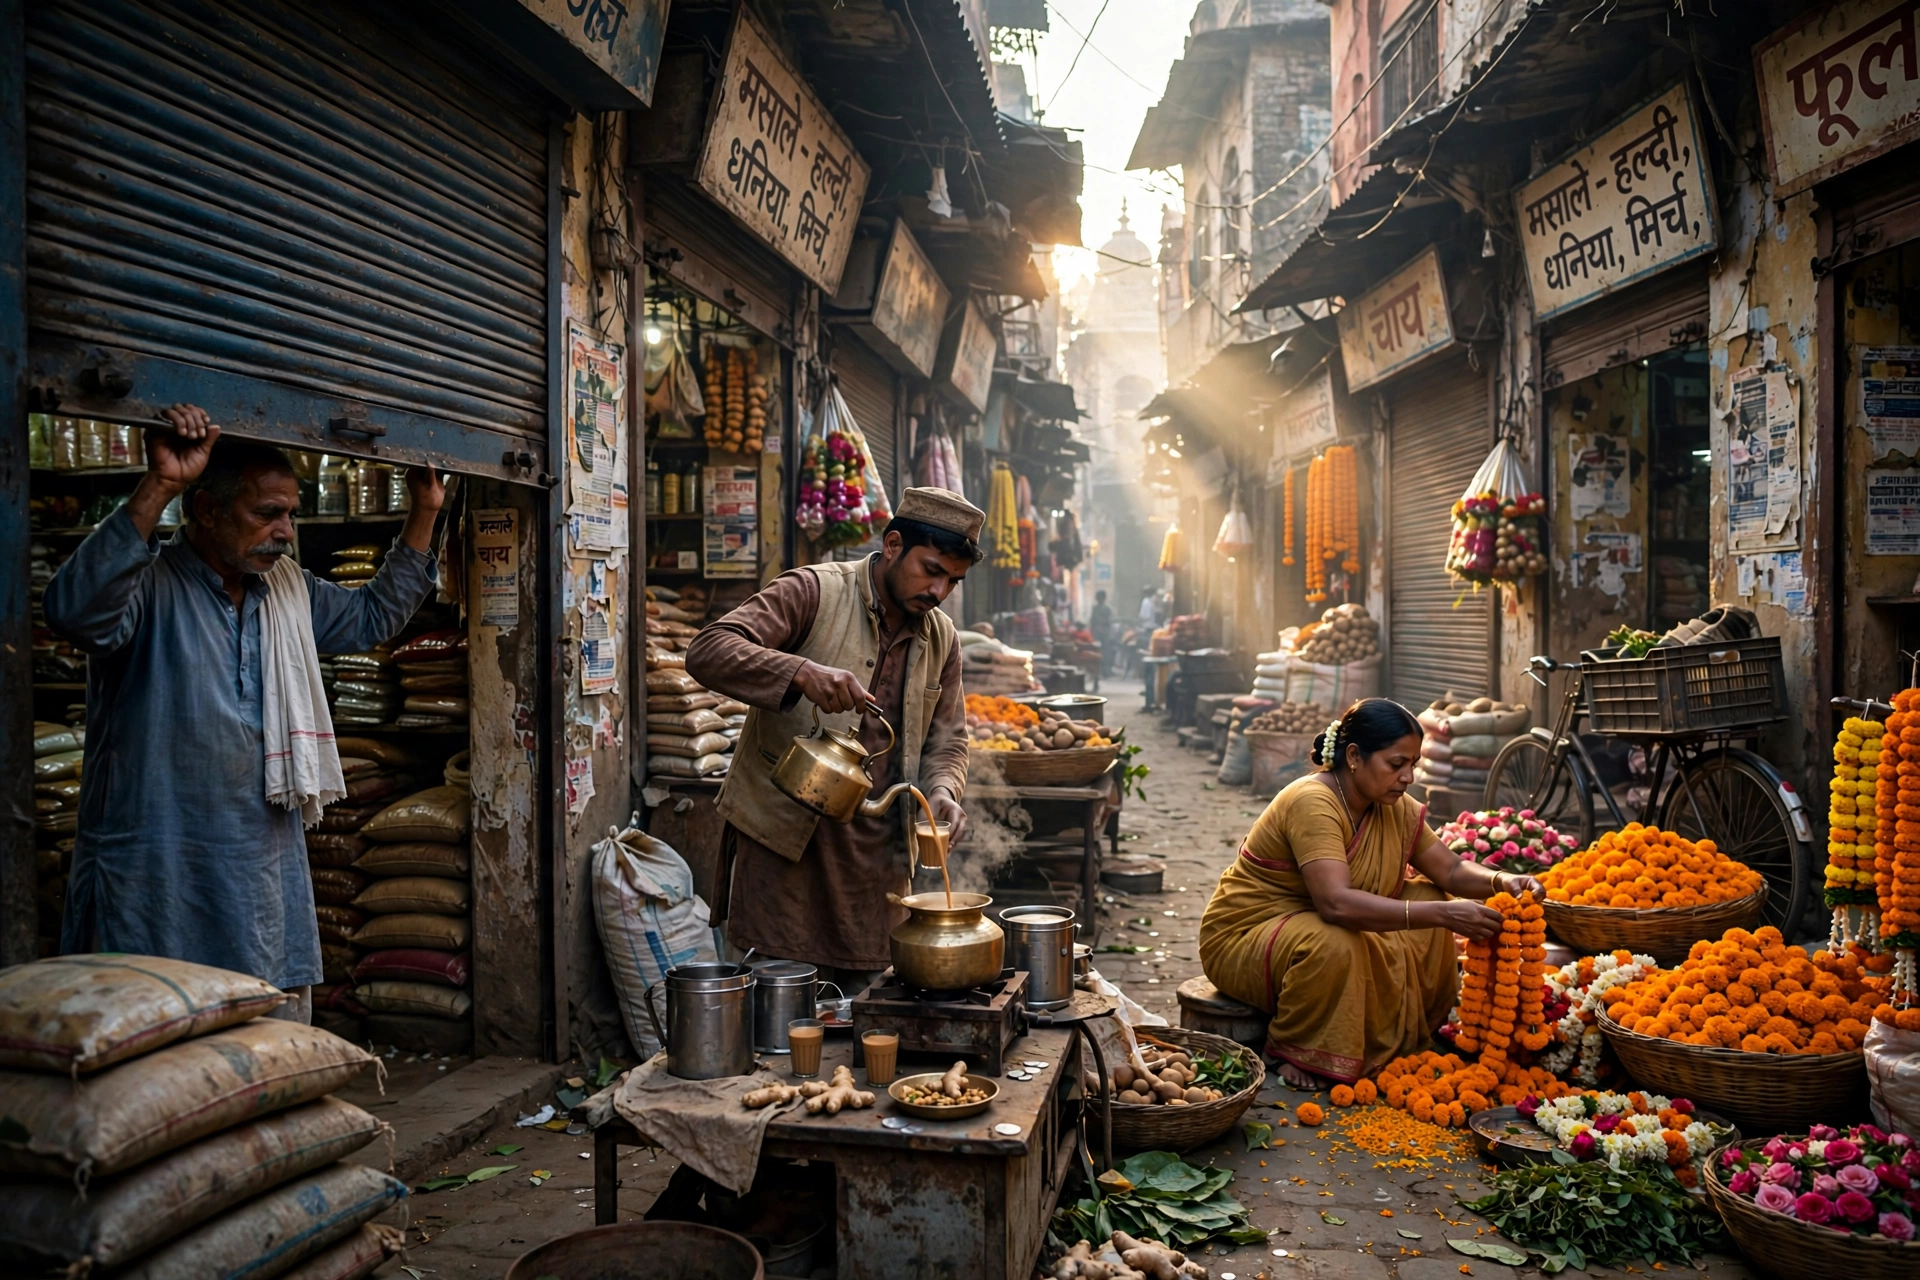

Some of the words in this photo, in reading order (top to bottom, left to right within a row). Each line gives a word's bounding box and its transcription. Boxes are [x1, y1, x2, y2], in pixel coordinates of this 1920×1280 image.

[1786, 2, 1919, 147] फूल
[740, 56, 803, 162] मसाले
[810, 140, 851, 222] हल्दी,
[1526, 158, 1592, 237] मसाले
[1609, 104, 1691, 195] हल्दी,
[794, 190, 834, 274] मिर्च,
[1544, 231, 1625, 290] धनिया,
[1625, 170, 1701, 257] मिर्च,
[1369, 280, 1425, 352] चाय
[478, 546, 512, 565] चाय
